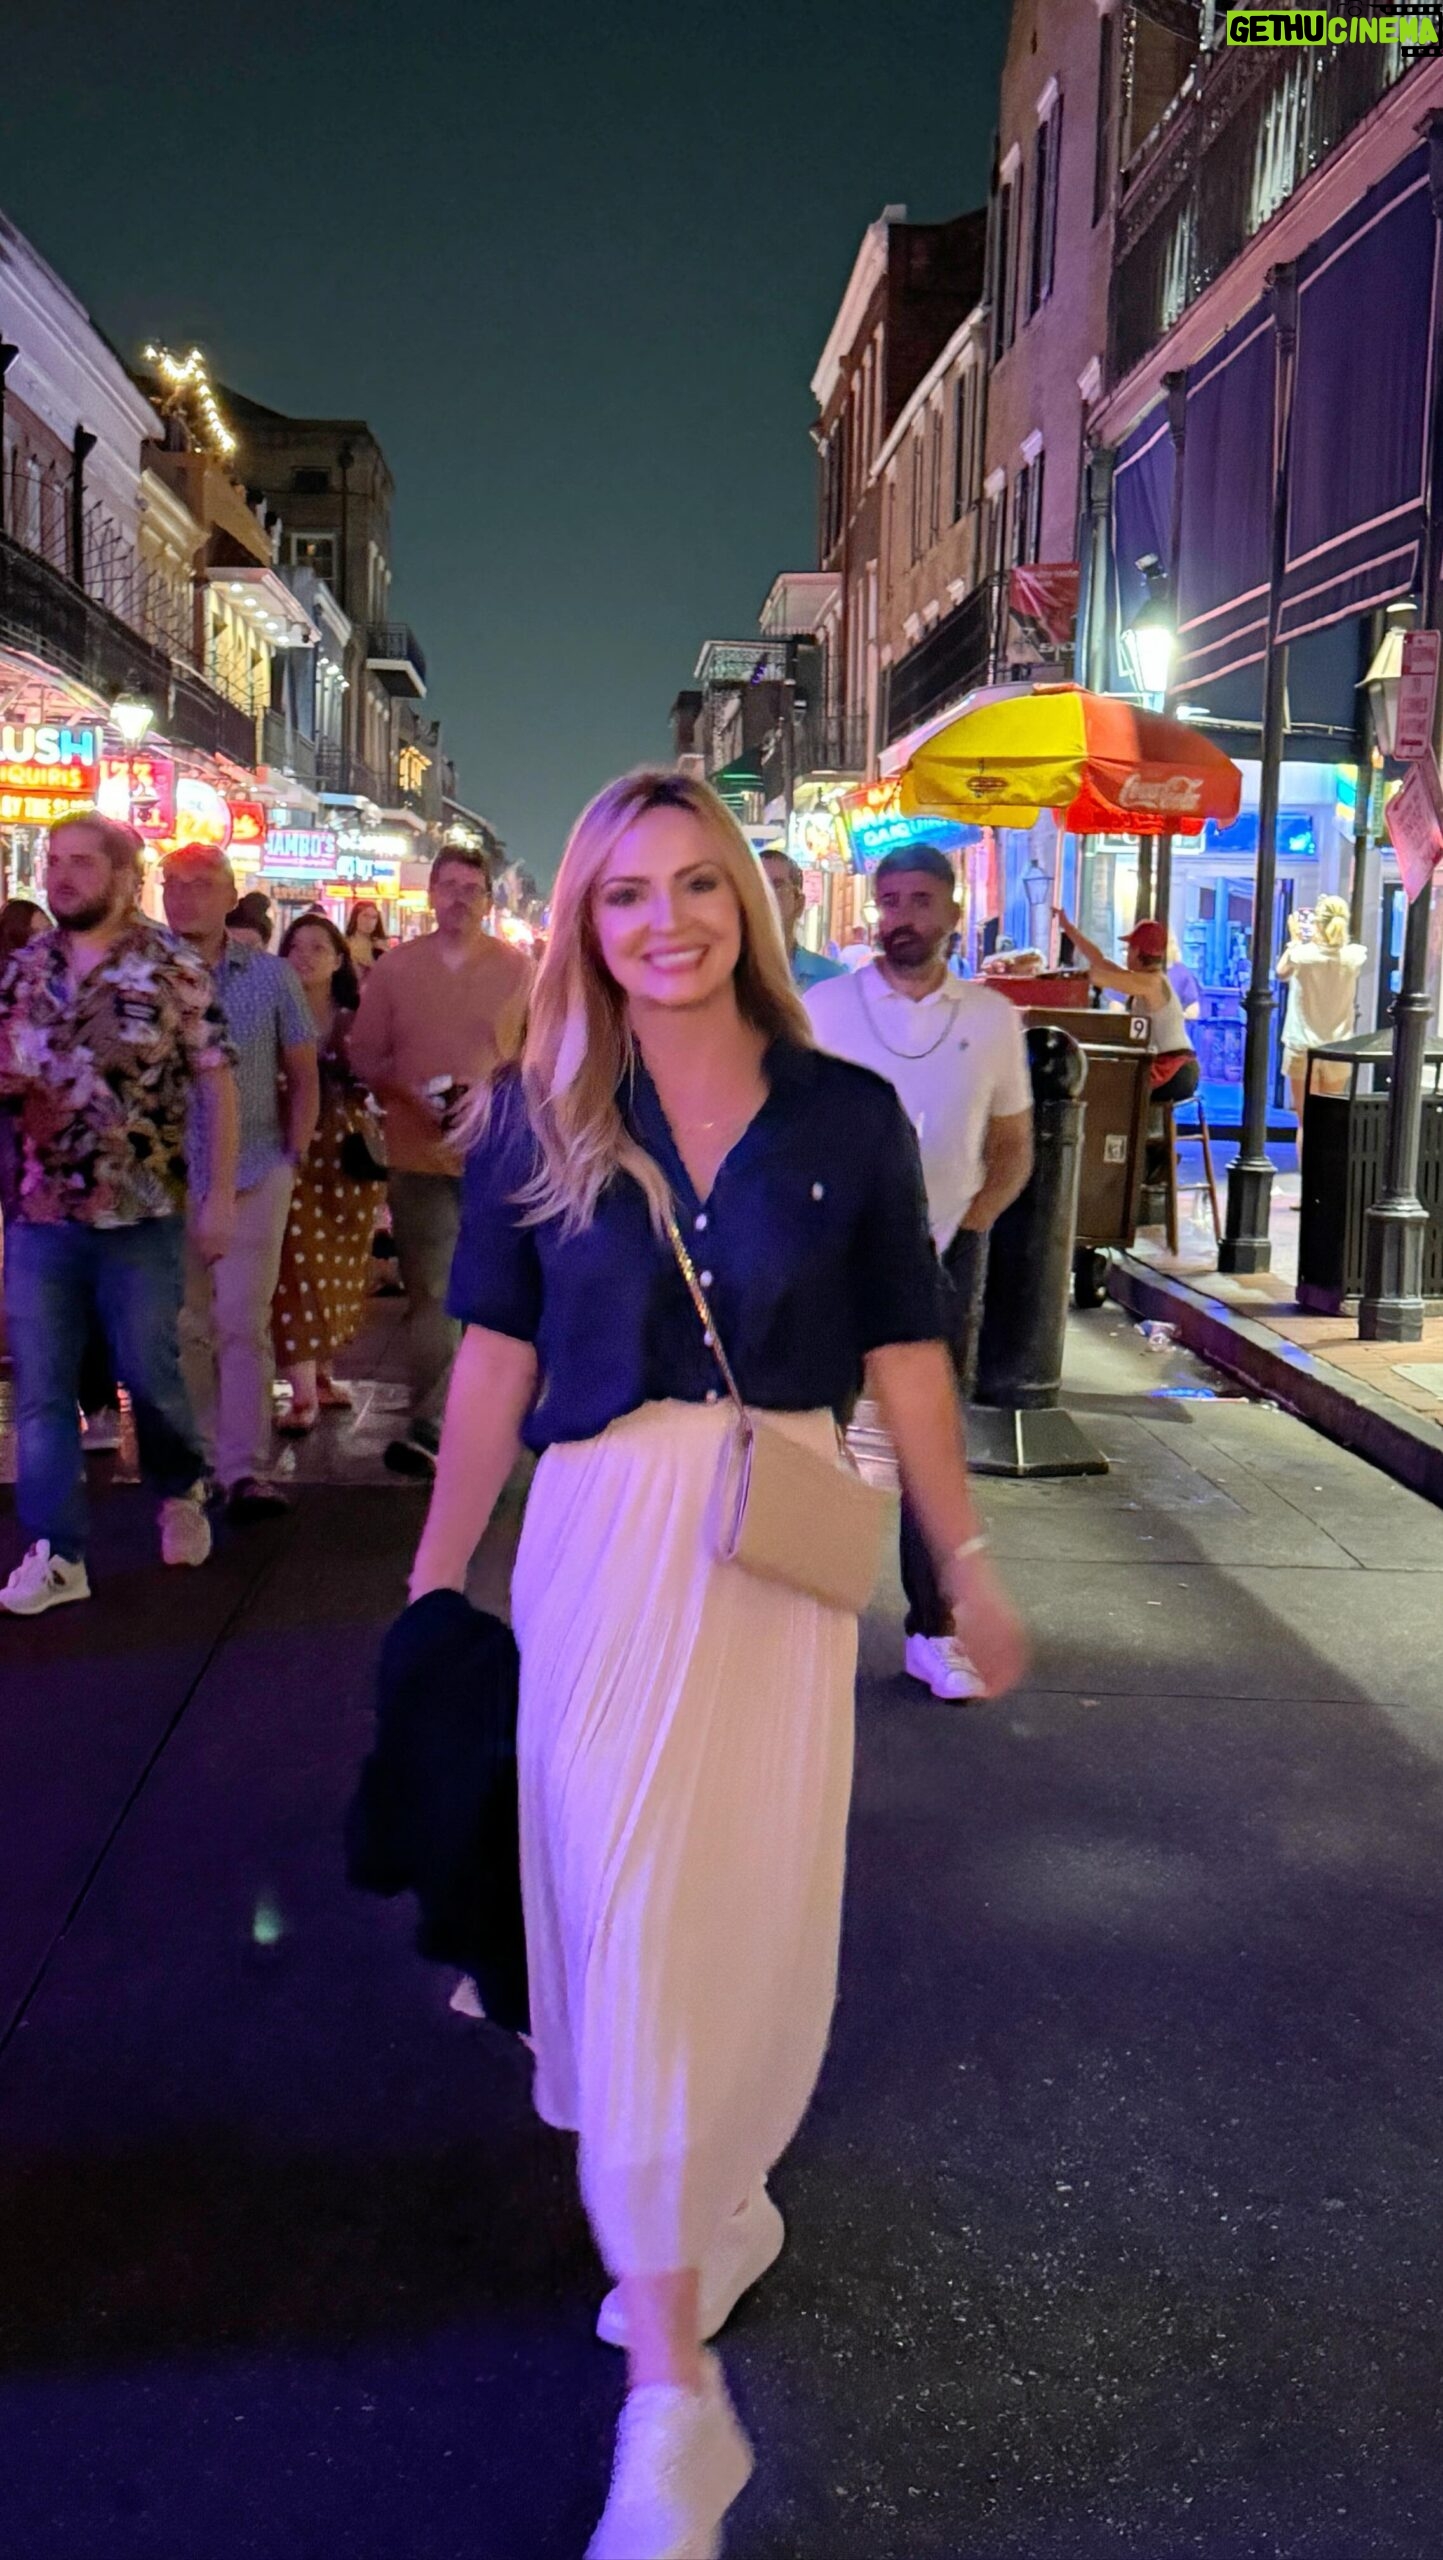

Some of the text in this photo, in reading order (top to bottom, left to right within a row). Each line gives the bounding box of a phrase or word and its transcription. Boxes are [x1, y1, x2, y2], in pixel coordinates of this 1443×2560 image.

[0, 725, 93, 766] USH
[1119, 773, 1204, 812] Coca-Cola
[1133, 1019, 1145, 1039] 9
